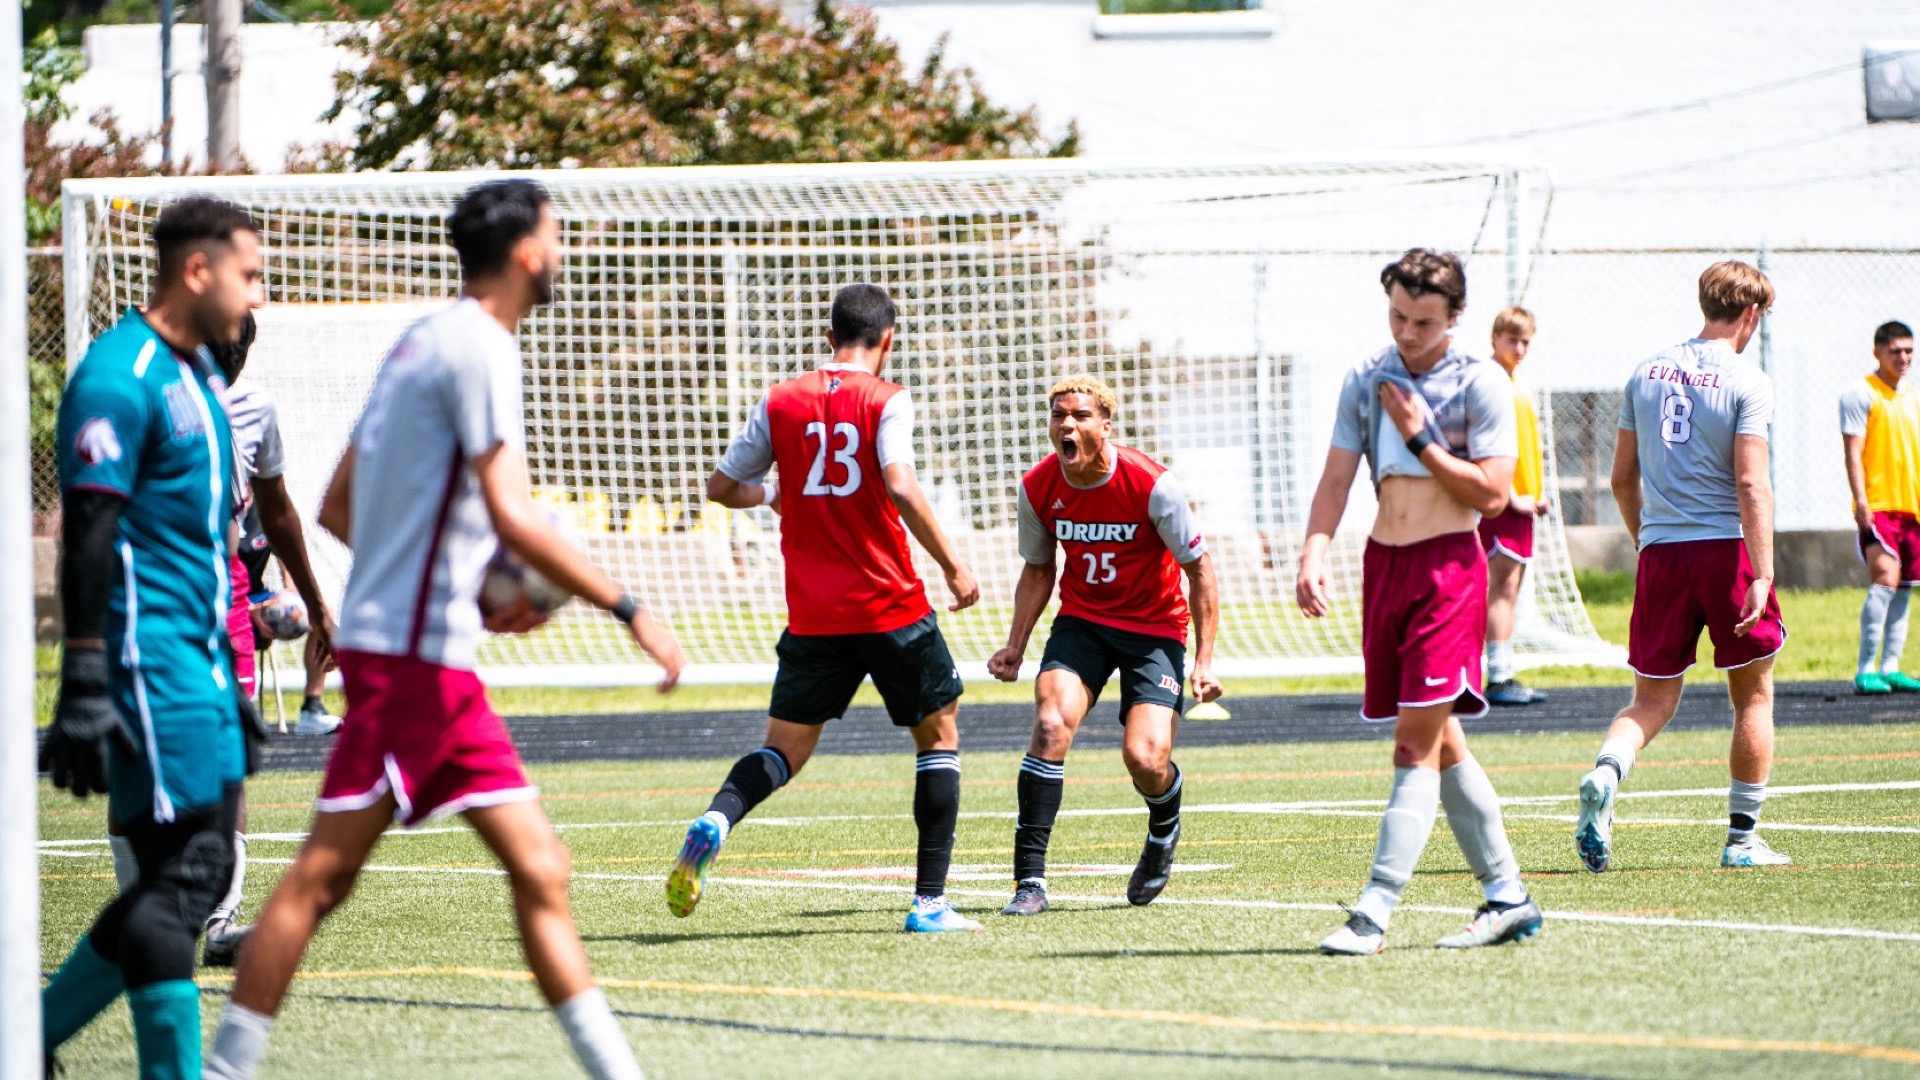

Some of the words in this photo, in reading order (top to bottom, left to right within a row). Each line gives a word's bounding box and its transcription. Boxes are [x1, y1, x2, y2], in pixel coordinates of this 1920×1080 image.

[1648, 366, 1720, 388] EVANGEL
[1660, 394, 1694, 444] 8
[802, 421, 862, 496] 23
[1055, 520, 1138, 542] DRURY
[1083, 553, 1117, 583] 25
